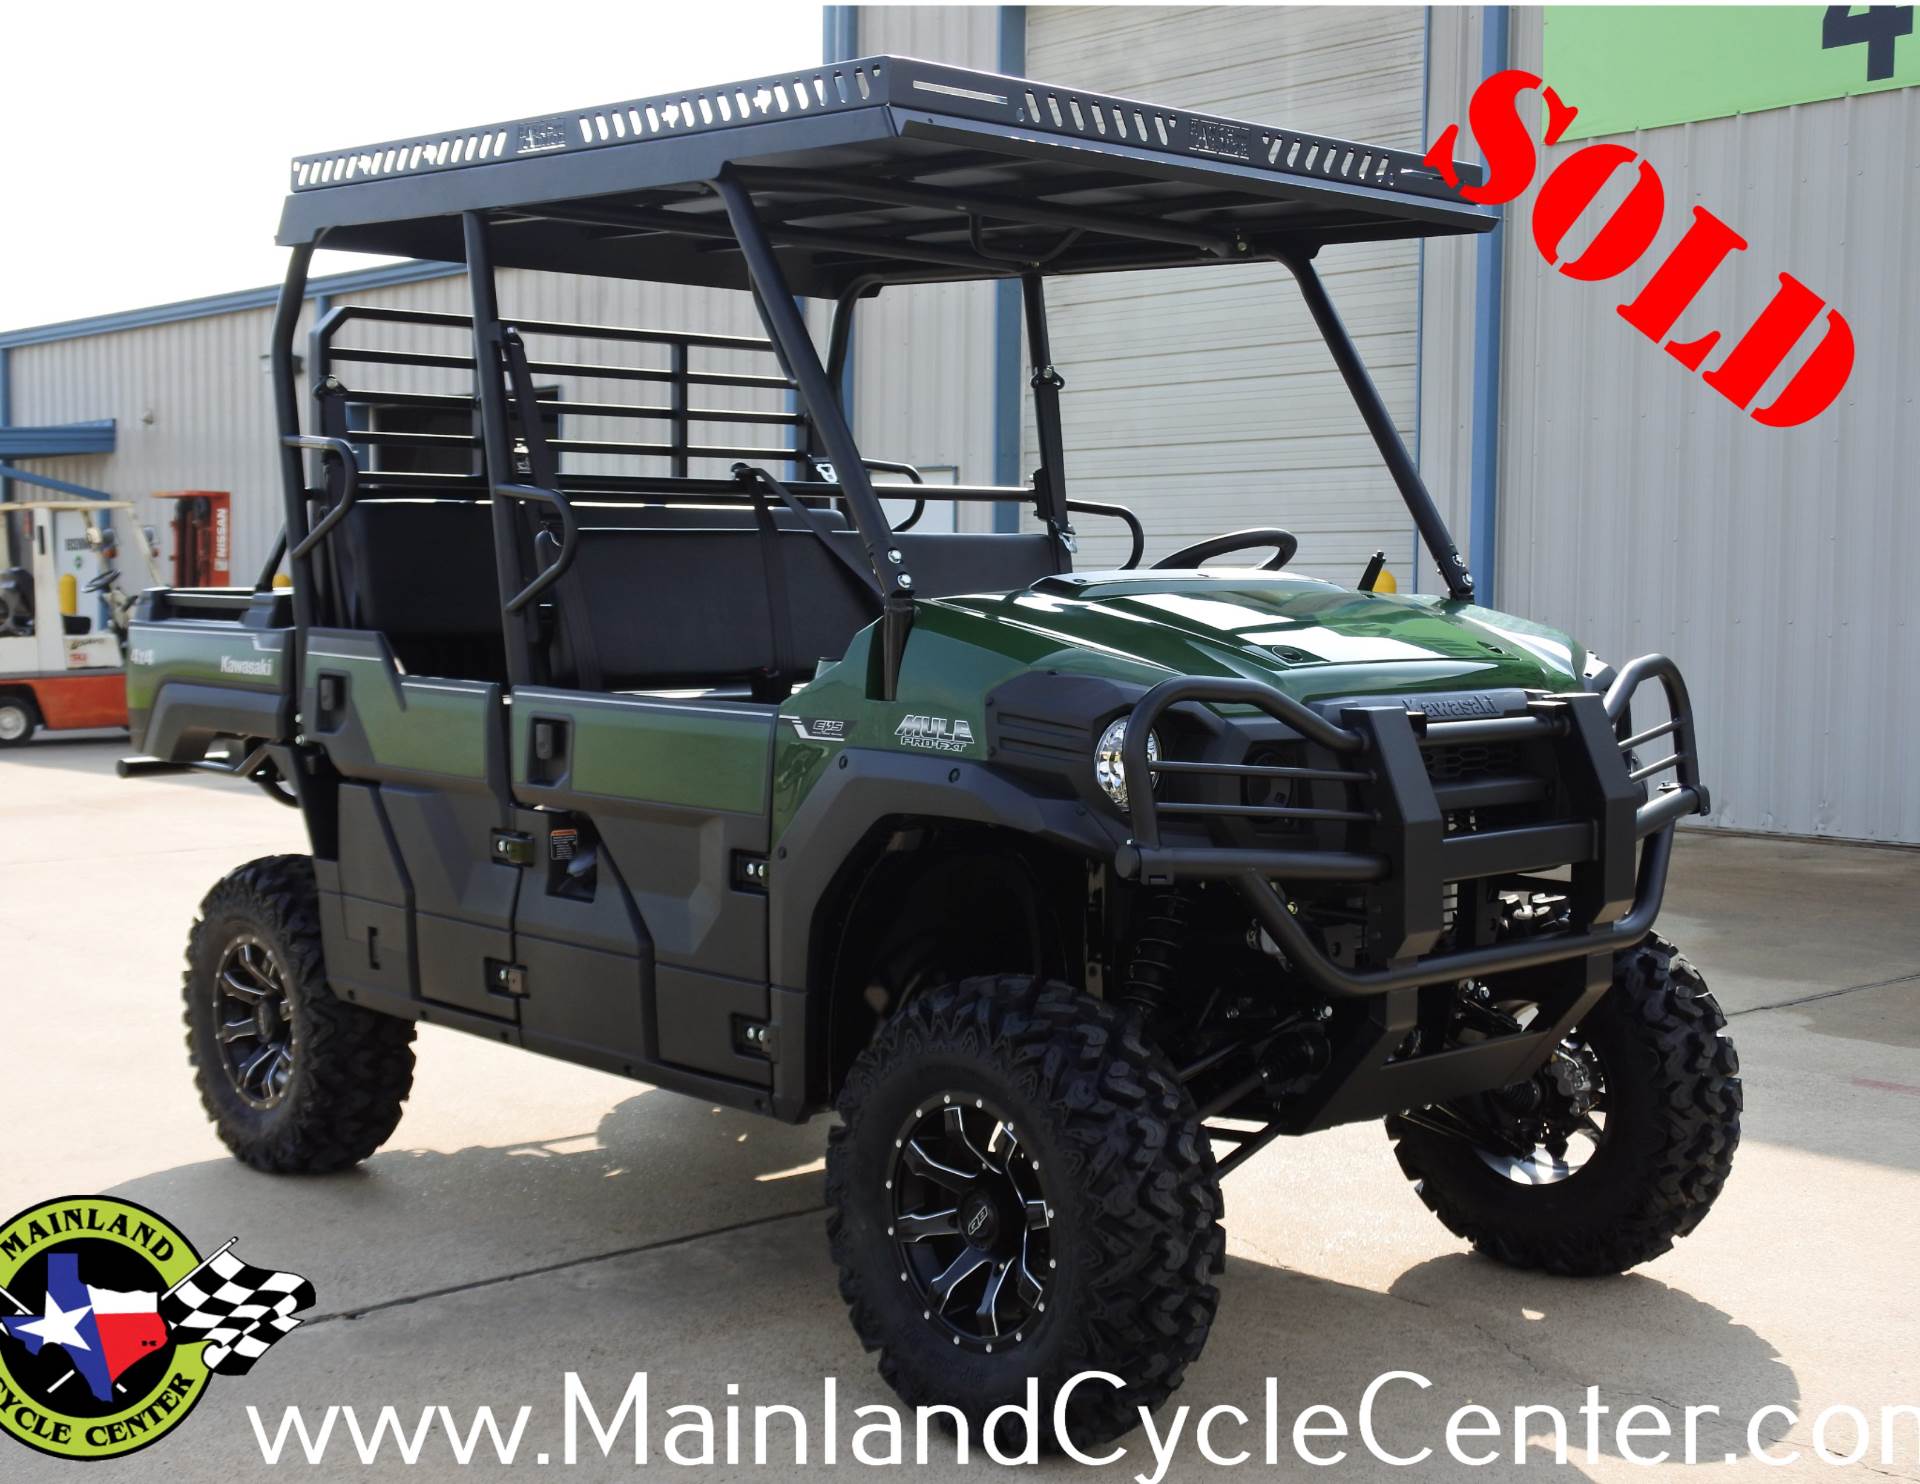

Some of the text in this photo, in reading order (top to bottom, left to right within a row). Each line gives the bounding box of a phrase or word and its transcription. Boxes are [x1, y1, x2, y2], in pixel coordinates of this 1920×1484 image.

[1822, 5, 1914, 82] 4
[216, 508, 229, 558] NISSAN
[220, 655, 273, 677] Kawasaki
[1402, 695, 1500, 718] Kawasaki
[894, 714, 975, 744] MULE
